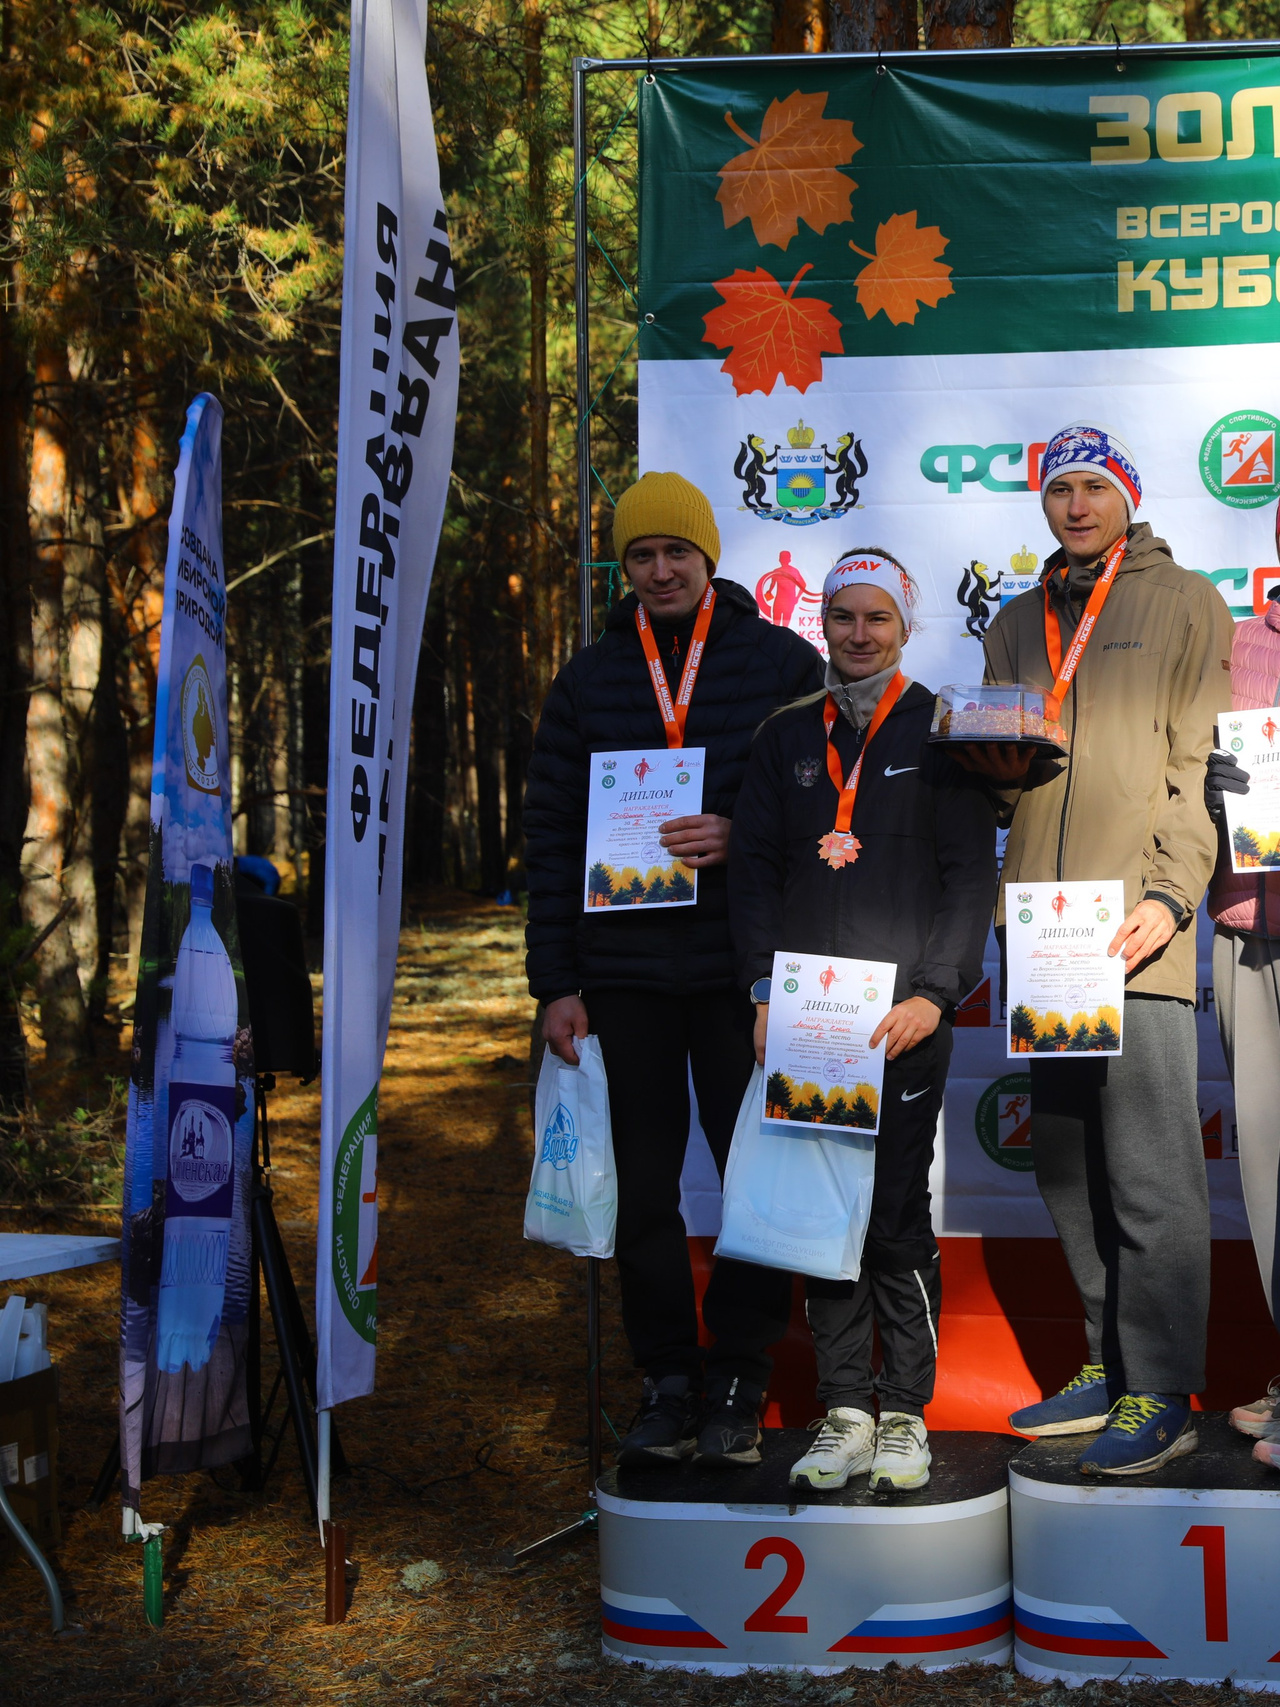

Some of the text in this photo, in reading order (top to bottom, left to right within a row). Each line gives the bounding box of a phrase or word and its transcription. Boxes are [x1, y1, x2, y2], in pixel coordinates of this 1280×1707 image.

[1228, 414, 1277, 429] СПОРТИВНОГО
[1203, 424, 1226, 462] ФЕДЕРАЦИЯ
[1203, 465, 1223, 495] ОБЛАСТИ
[1101, 550, 1122, 583] ТЮМЕНЬ
[798, 616, 824, 627] КУБ
[1063, 615, 1096, 682] ЗОЛОТАЯ ОСЕНЬ
[1102, 641, 1131, 652] PATRIOT
[682, 641, 704, 706] ЗОЛОТАЯ ОСЕНЬ
[619, 789, 674, 803] ДИПЛОМ
[843, 838, 854, 850] 2
[1038, 927, 1095, 940] ДИПЛОМ
[801, 999, 860, 1015] ДИПЛОМ
[805, 1016, 854, 1026] НАГРАЖДАЕТСЯ
[336, 1111, 372, 1216] ФЕДЕРАЦИЯ
[336, 1233, 360, 1310] ОБЛАСТИ
[743, 1535, 809, 1634] 2
[1179, 1524, 1227, 1642] 1
